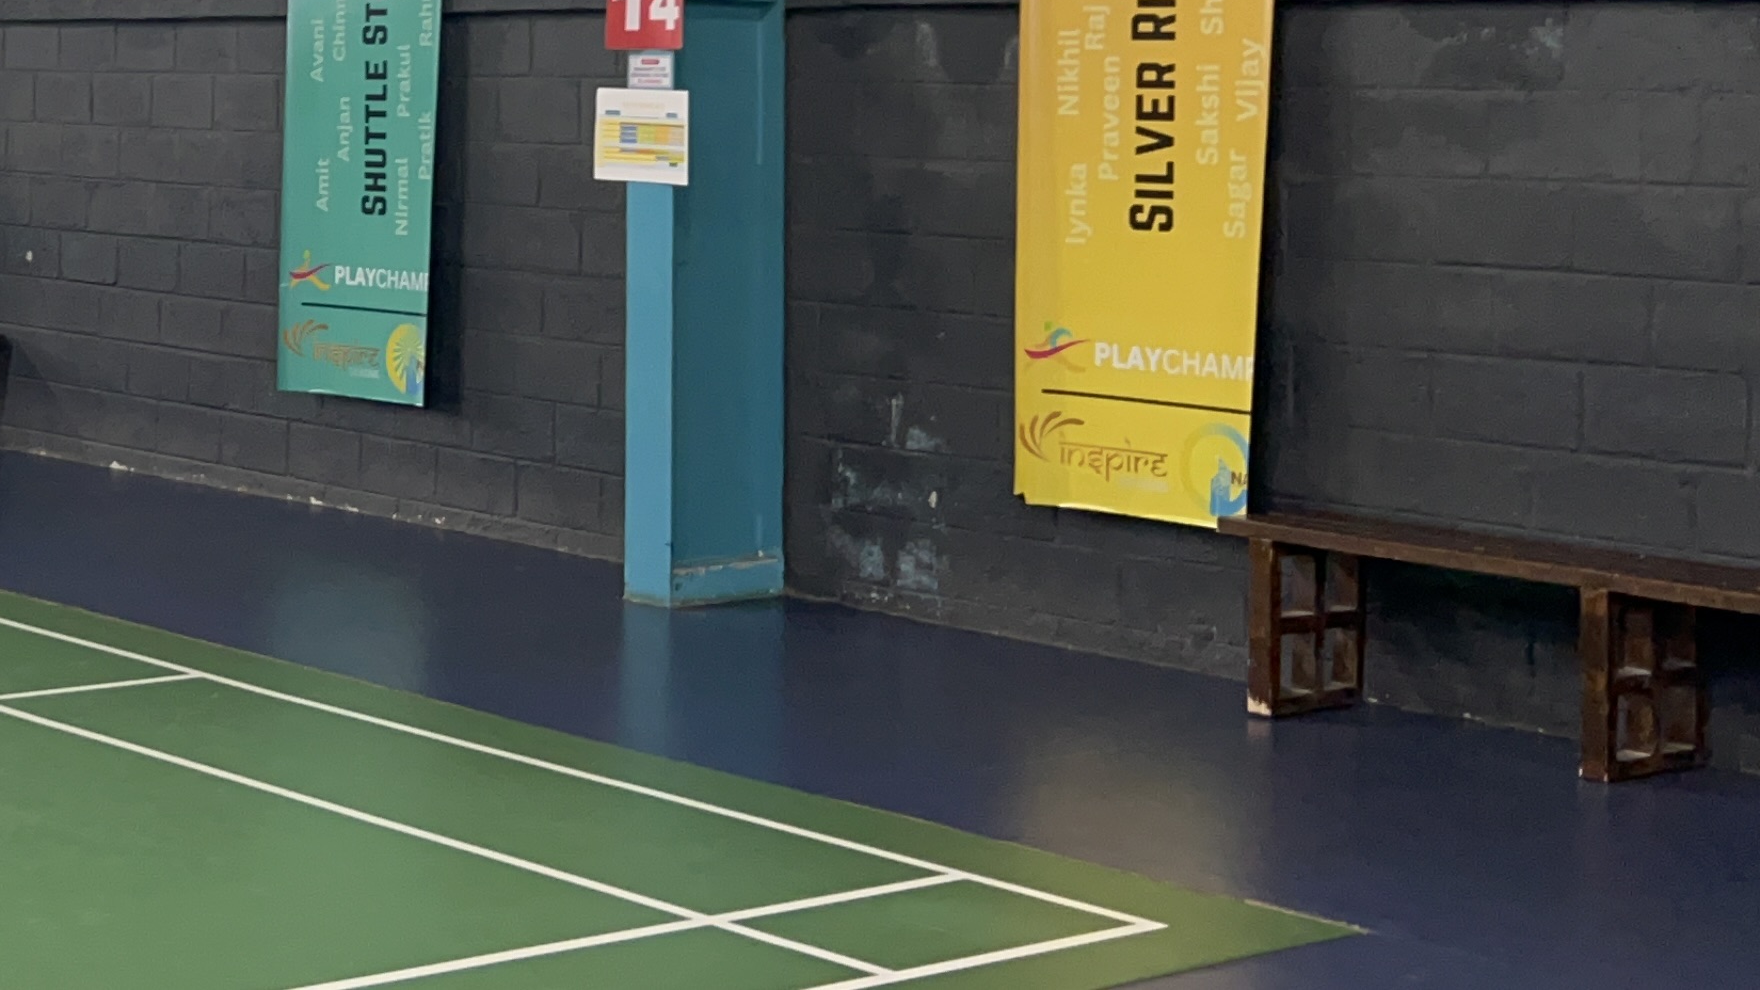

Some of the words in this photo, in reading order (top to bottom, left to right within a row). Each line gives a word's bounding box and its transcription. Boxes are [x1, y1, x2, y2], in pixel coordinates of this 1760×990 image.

[310, 19, 324, 83] Avani
[1083, 4, 1111, 51] Raj
[396, 44, 412, 118] Prakul
[1057, 28, 1081, 116] Nikhil
[1234, 37, 1266, 122] Vijay
[336, 96, 354, 162] Anjan
[360, 60, 388, 216] SHUTTLE
[417, 110, 433, 181] Pratik
[1097, 55, 1121, 182] Praveen
[1128, 62, 1177, 232] SILVER
[1195, 63, 1220, 166] Sakshi
[315, 157, 330, 212] Amit
[394, 157, 409, 237] Nirmal
[1222, 148, 1252, 239] Sagar
